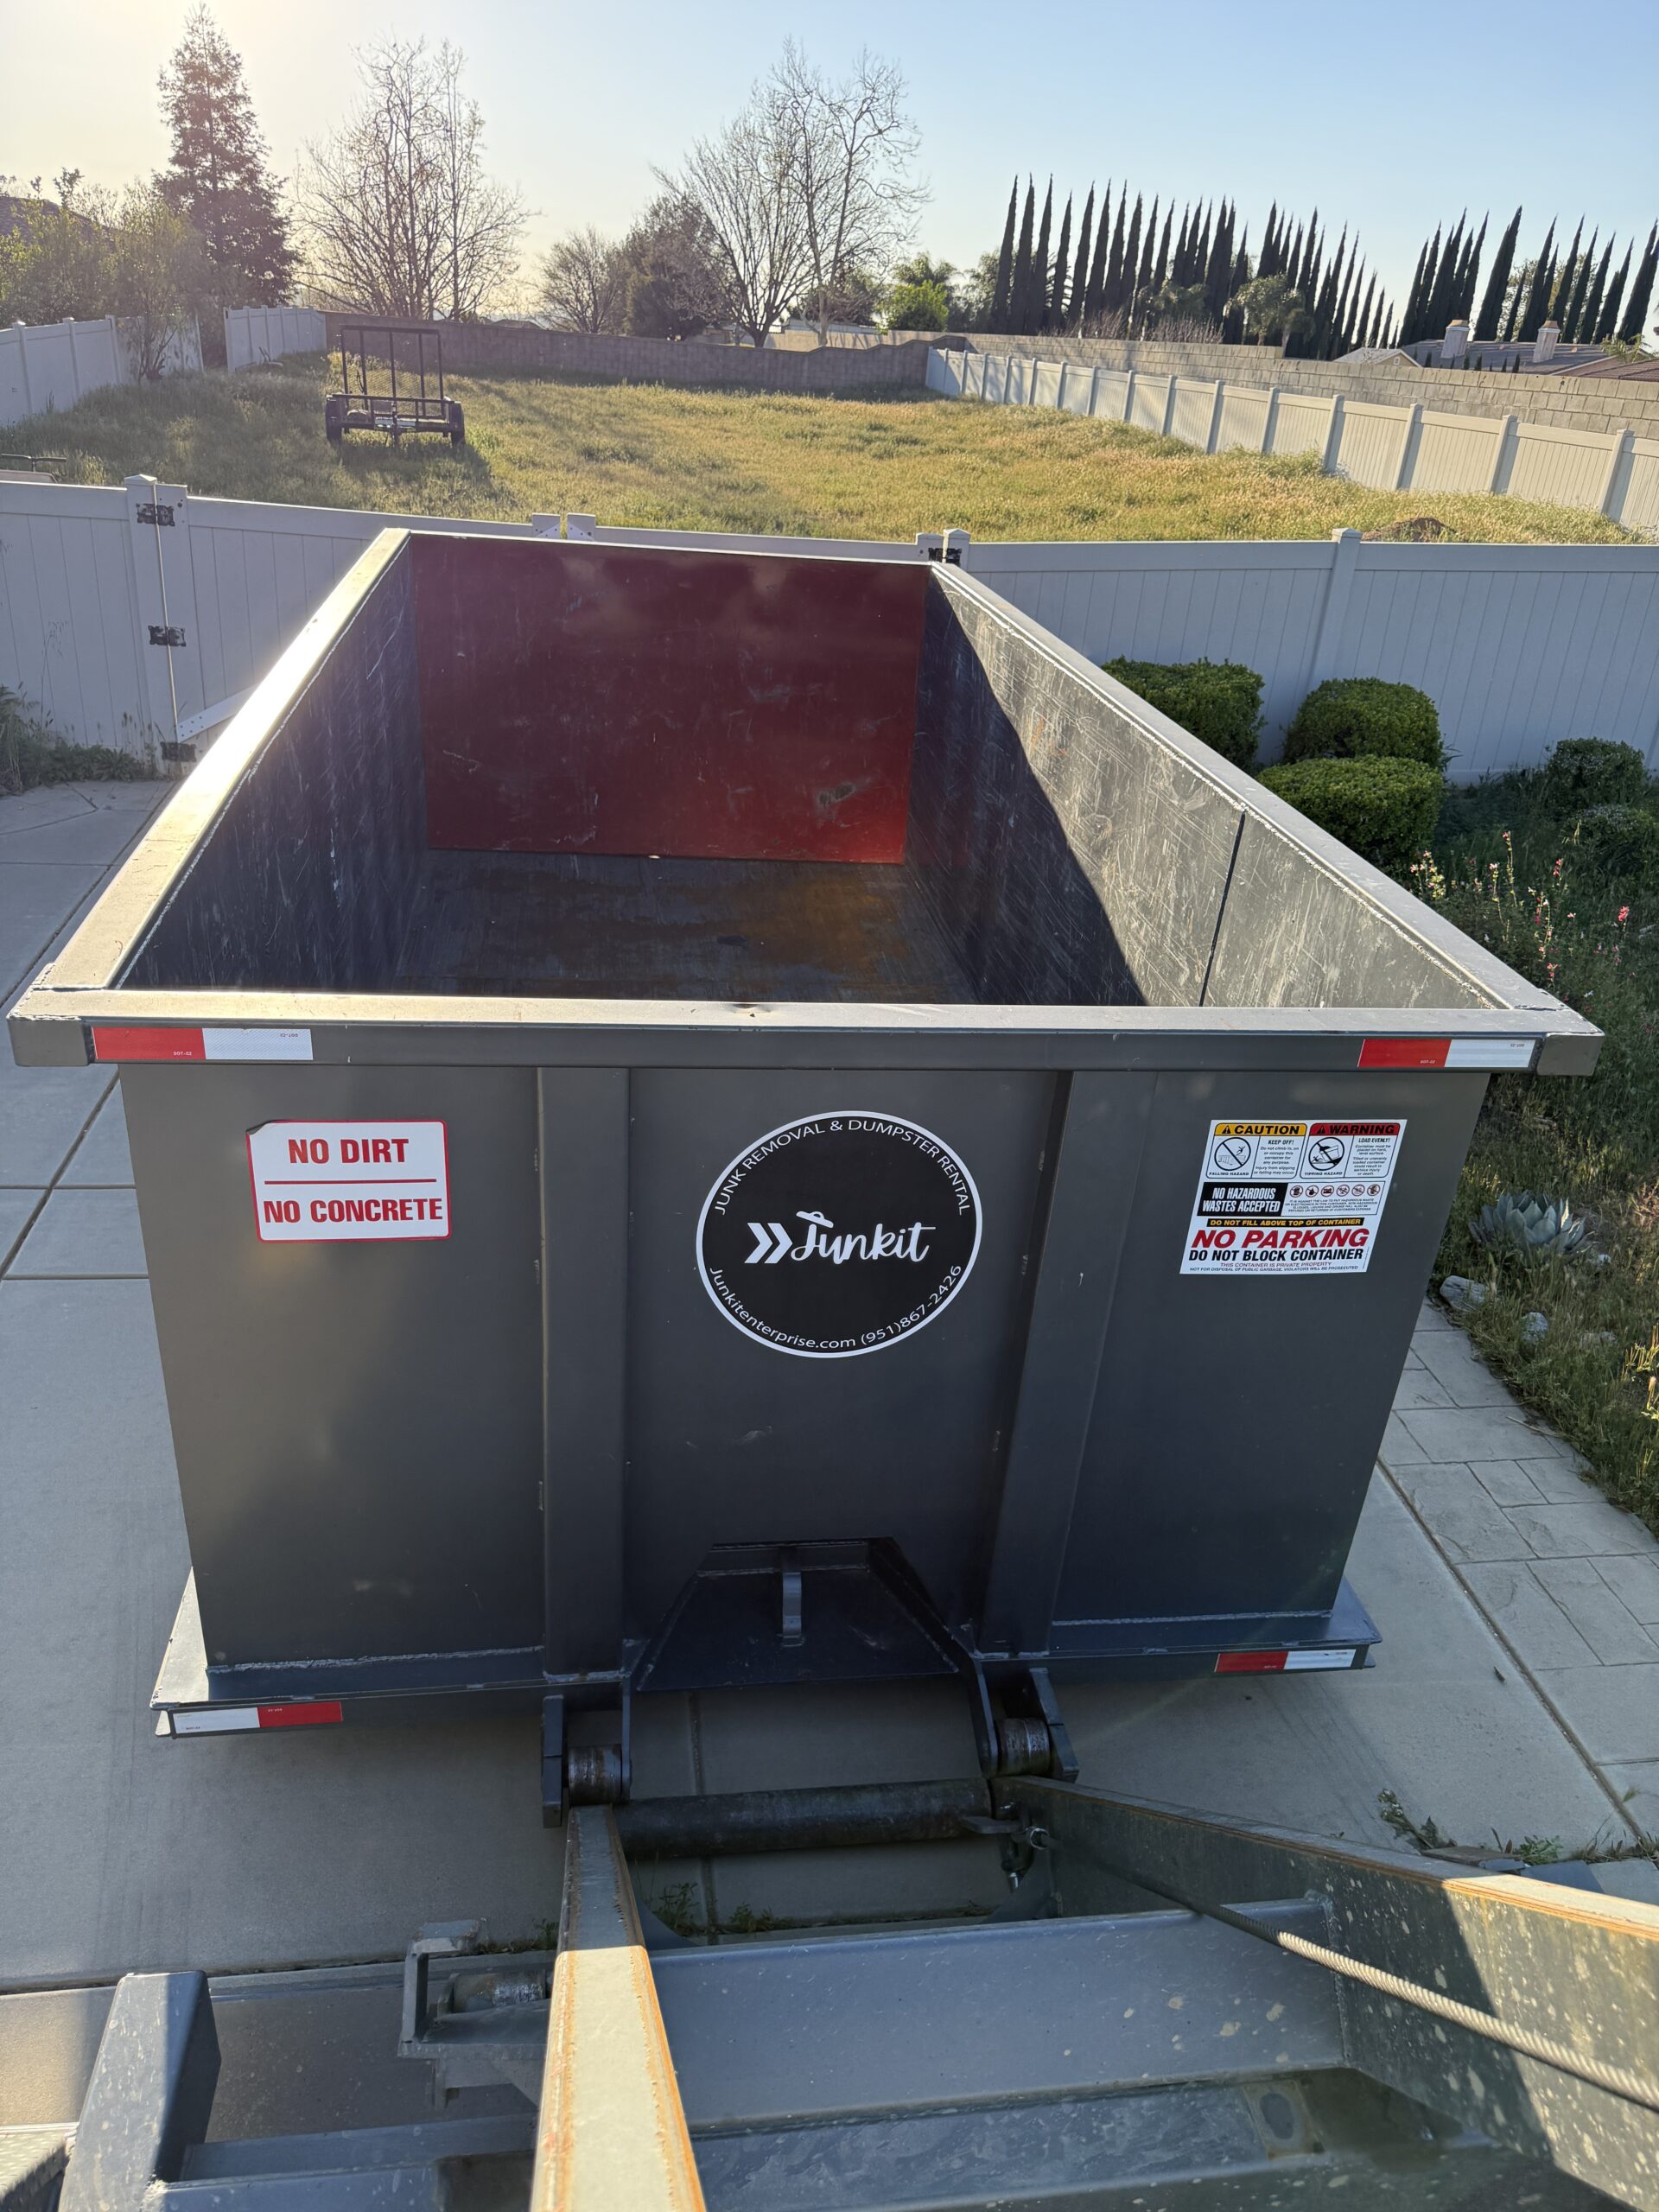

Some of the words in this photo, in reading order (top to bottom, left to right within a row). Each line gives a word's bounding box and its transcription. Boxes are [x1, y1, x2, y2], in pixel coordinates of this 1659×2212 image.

[1235, 1125, 1300, 1135] CAUTION
[1330, 1124, 1395, 1135] WARNING
[289, 1139, 329, 1164] NO
[340, 1139, 409, 1164] DIRT
[715, 1171, 747, 1215] JUNK
[742, 1123, 825, 1170] REMOVAL
[830, 1120, 843, 1131] &
[849, 1120, 939, 1158] DUMPSTER
[937, 1155, 970, 1216] RENTAL
[1212, 1187, 1226, 1199] NO
[1227, 1187, 1276, 1200] HAZARDOUS
[264, 1200, 301, 1224] NO
[310, 1198, 443, 1223] CONCRETE
[1202, 1200, 1237, 1212] WASTES
[1237, 1200, 1281, 1212] ACCEPTED
[791, 1221, 936, 1264] Junkit
[1192, 1230, 1236, 1249] NO
[1241, 1228, 1370, 1249] PARKING
[1189, 1250, 1208, 1261] DO
[1211, 1250, 1239, 1261] NOT
[1243, 1250, 1287, 1261] BLOCK
[1290, 1249, 1363, 1261] CONTAINER
[709, 1268, 855, 1349] Junkitenterprise.com
[861, 1265, 961, 1345] (951)867-2426
